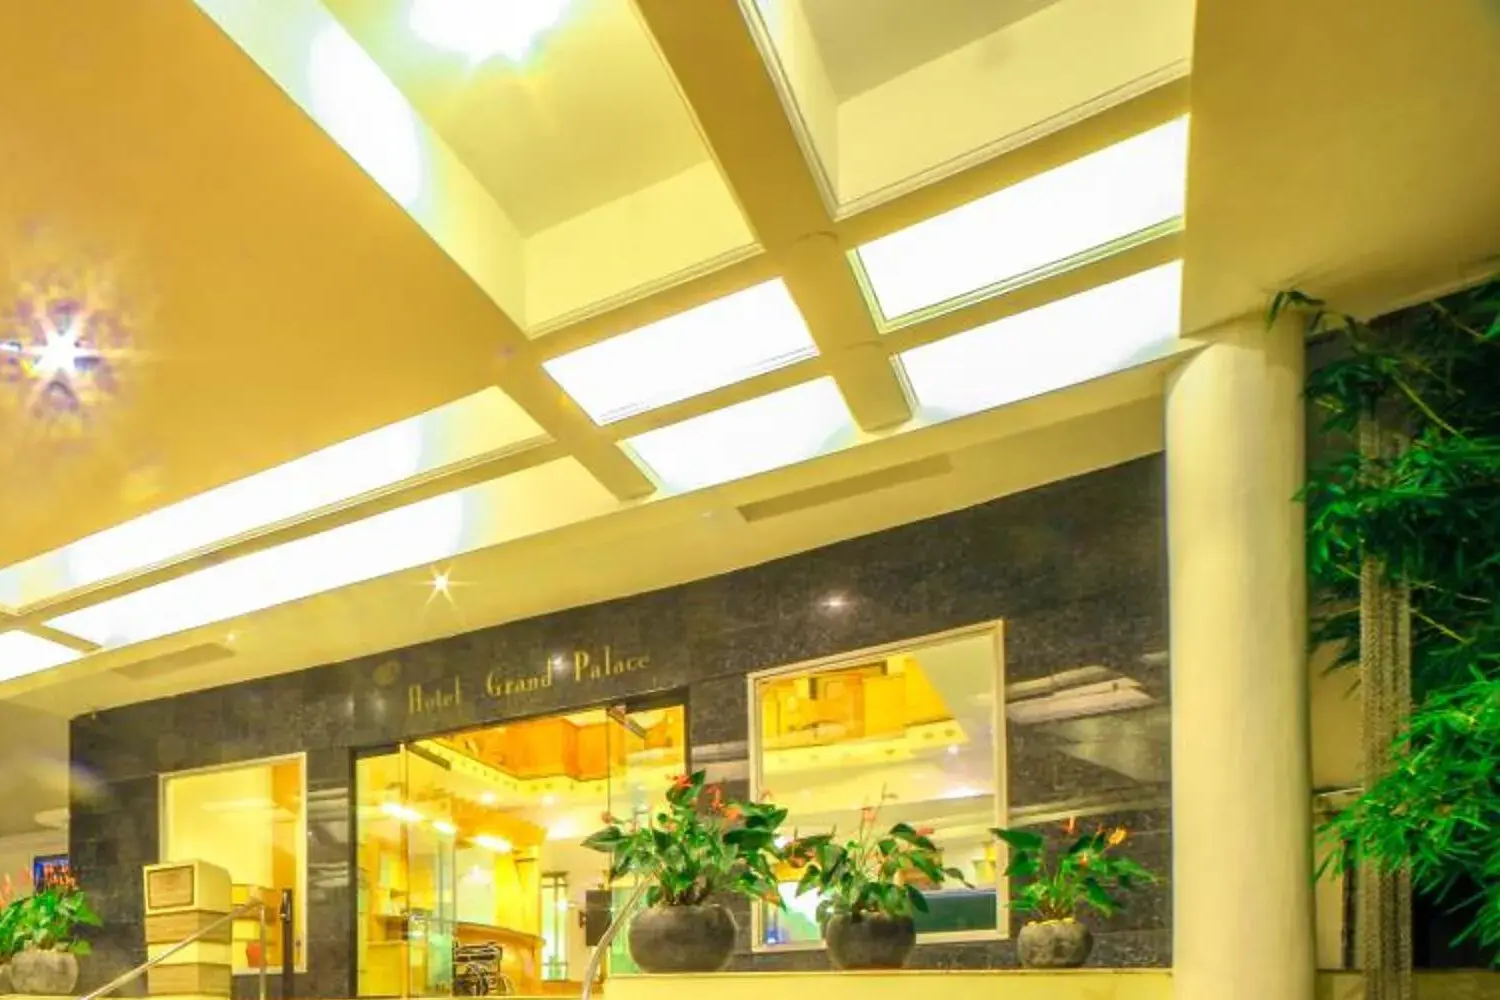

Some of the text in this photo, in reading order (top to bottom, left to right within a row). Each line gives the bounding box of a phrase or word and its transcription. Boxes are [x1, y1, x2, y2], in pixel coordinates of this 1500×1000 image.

[408, 645, 650, 715] Hotel Grand Palace
